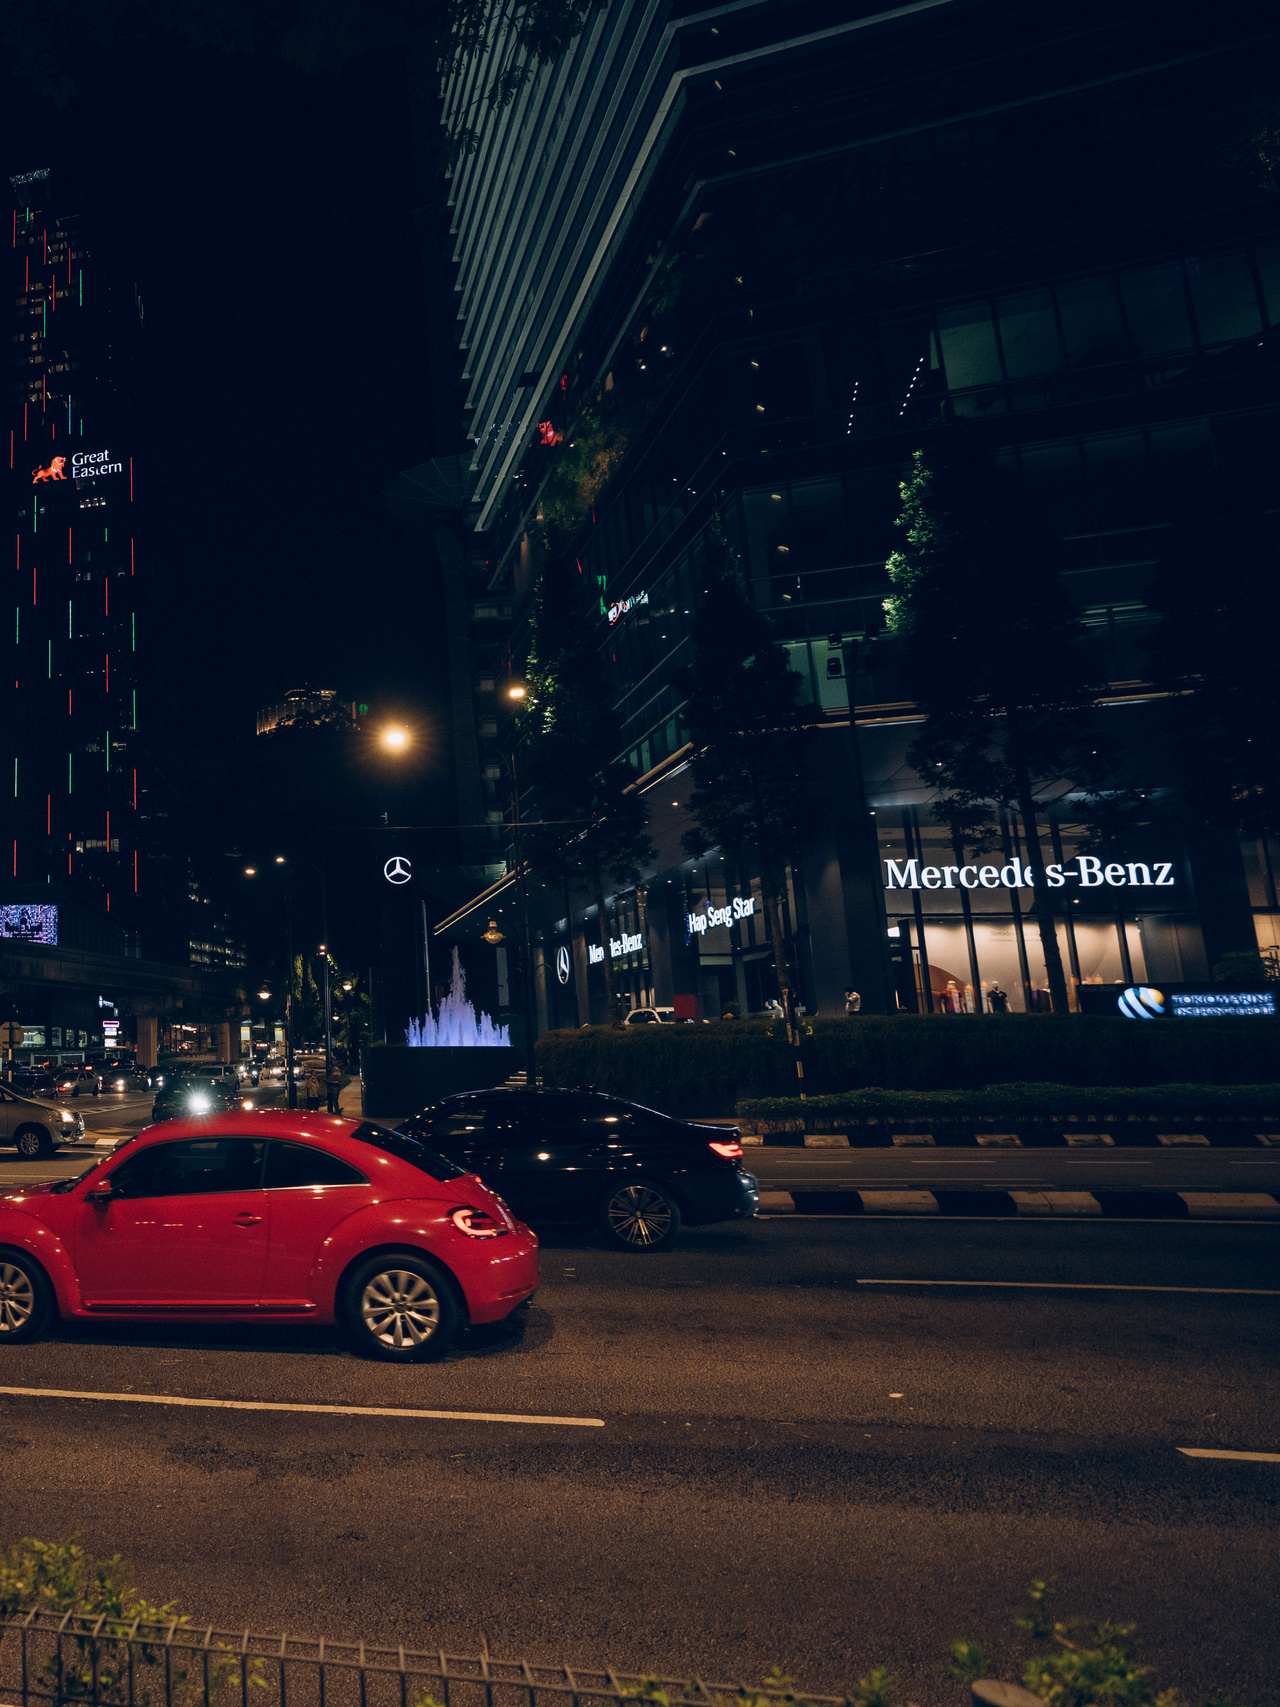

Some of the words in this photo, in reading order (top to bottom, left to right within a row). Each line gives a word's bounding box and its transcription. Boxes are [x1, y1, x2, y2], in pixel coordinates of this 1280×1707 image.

[72, 449, 110, 466] Great
[72, 462, 122, 479] Eastern
[689, 912, 708, 935] Hap
[707, 906, 734, 928] Seng
[732, 897, 755, 919] Star
[1172, 994, 1216, 1006] TOKIO
[1216, 993, 1275, 1005] MARINE
